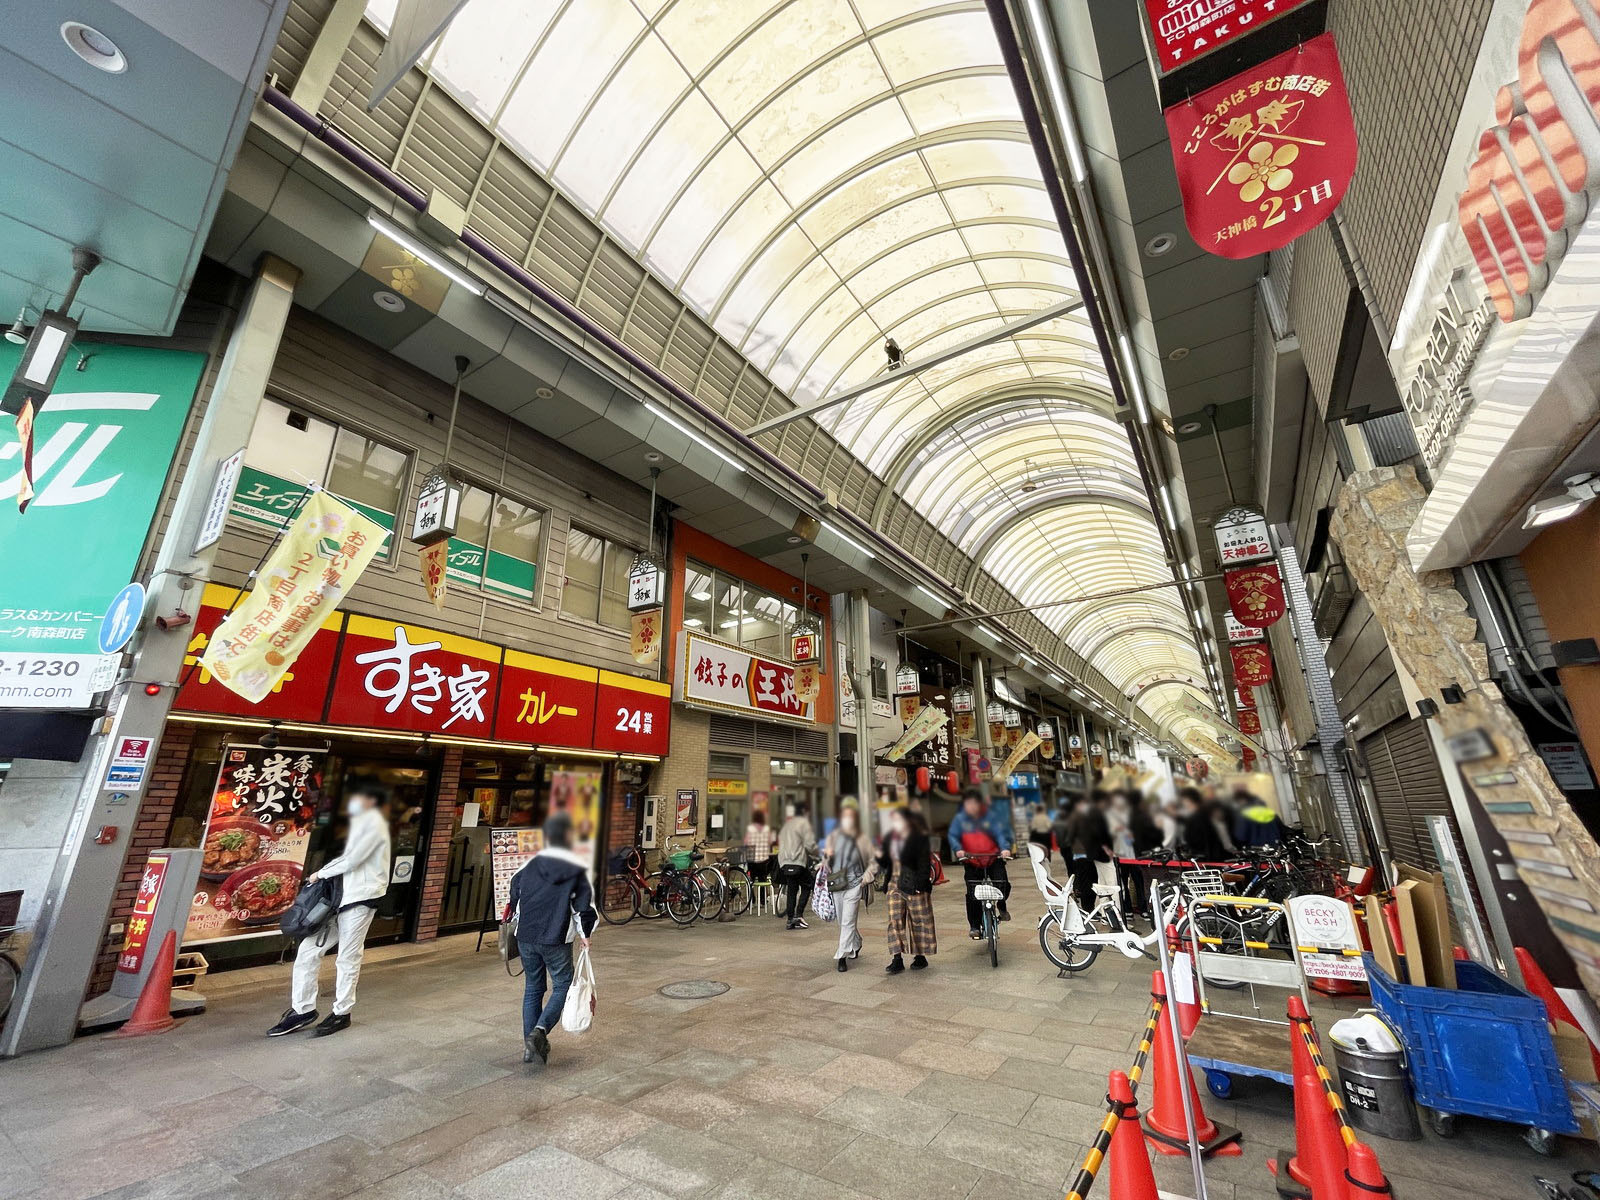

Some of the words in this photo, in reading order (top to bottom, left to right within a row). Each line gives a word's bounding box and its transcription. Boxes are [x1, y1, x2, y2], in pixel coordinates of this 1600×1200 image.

[1166, 31, 1186, 45] FC
[1184, 74, 1332, 154] こころがはずむ商店街
[1405, 362, 1433, 413] FOR
[448, 546, 484, 566] イブル
[1222, 543, 1270, 560] 天神橋2
[356, 626, 490, 730] すき家
[516, 687, 578, 724] カレー
[615, 707, 642, 733] 24
[231, 763, 257, 809] 味わい
[251, 753, 293, 824] 炭火の
[289, 754, 314, 811] 香ばしい
[1304, 908, 1335, 918] BECKY
[1306, 917, 1338, 927] LASH
